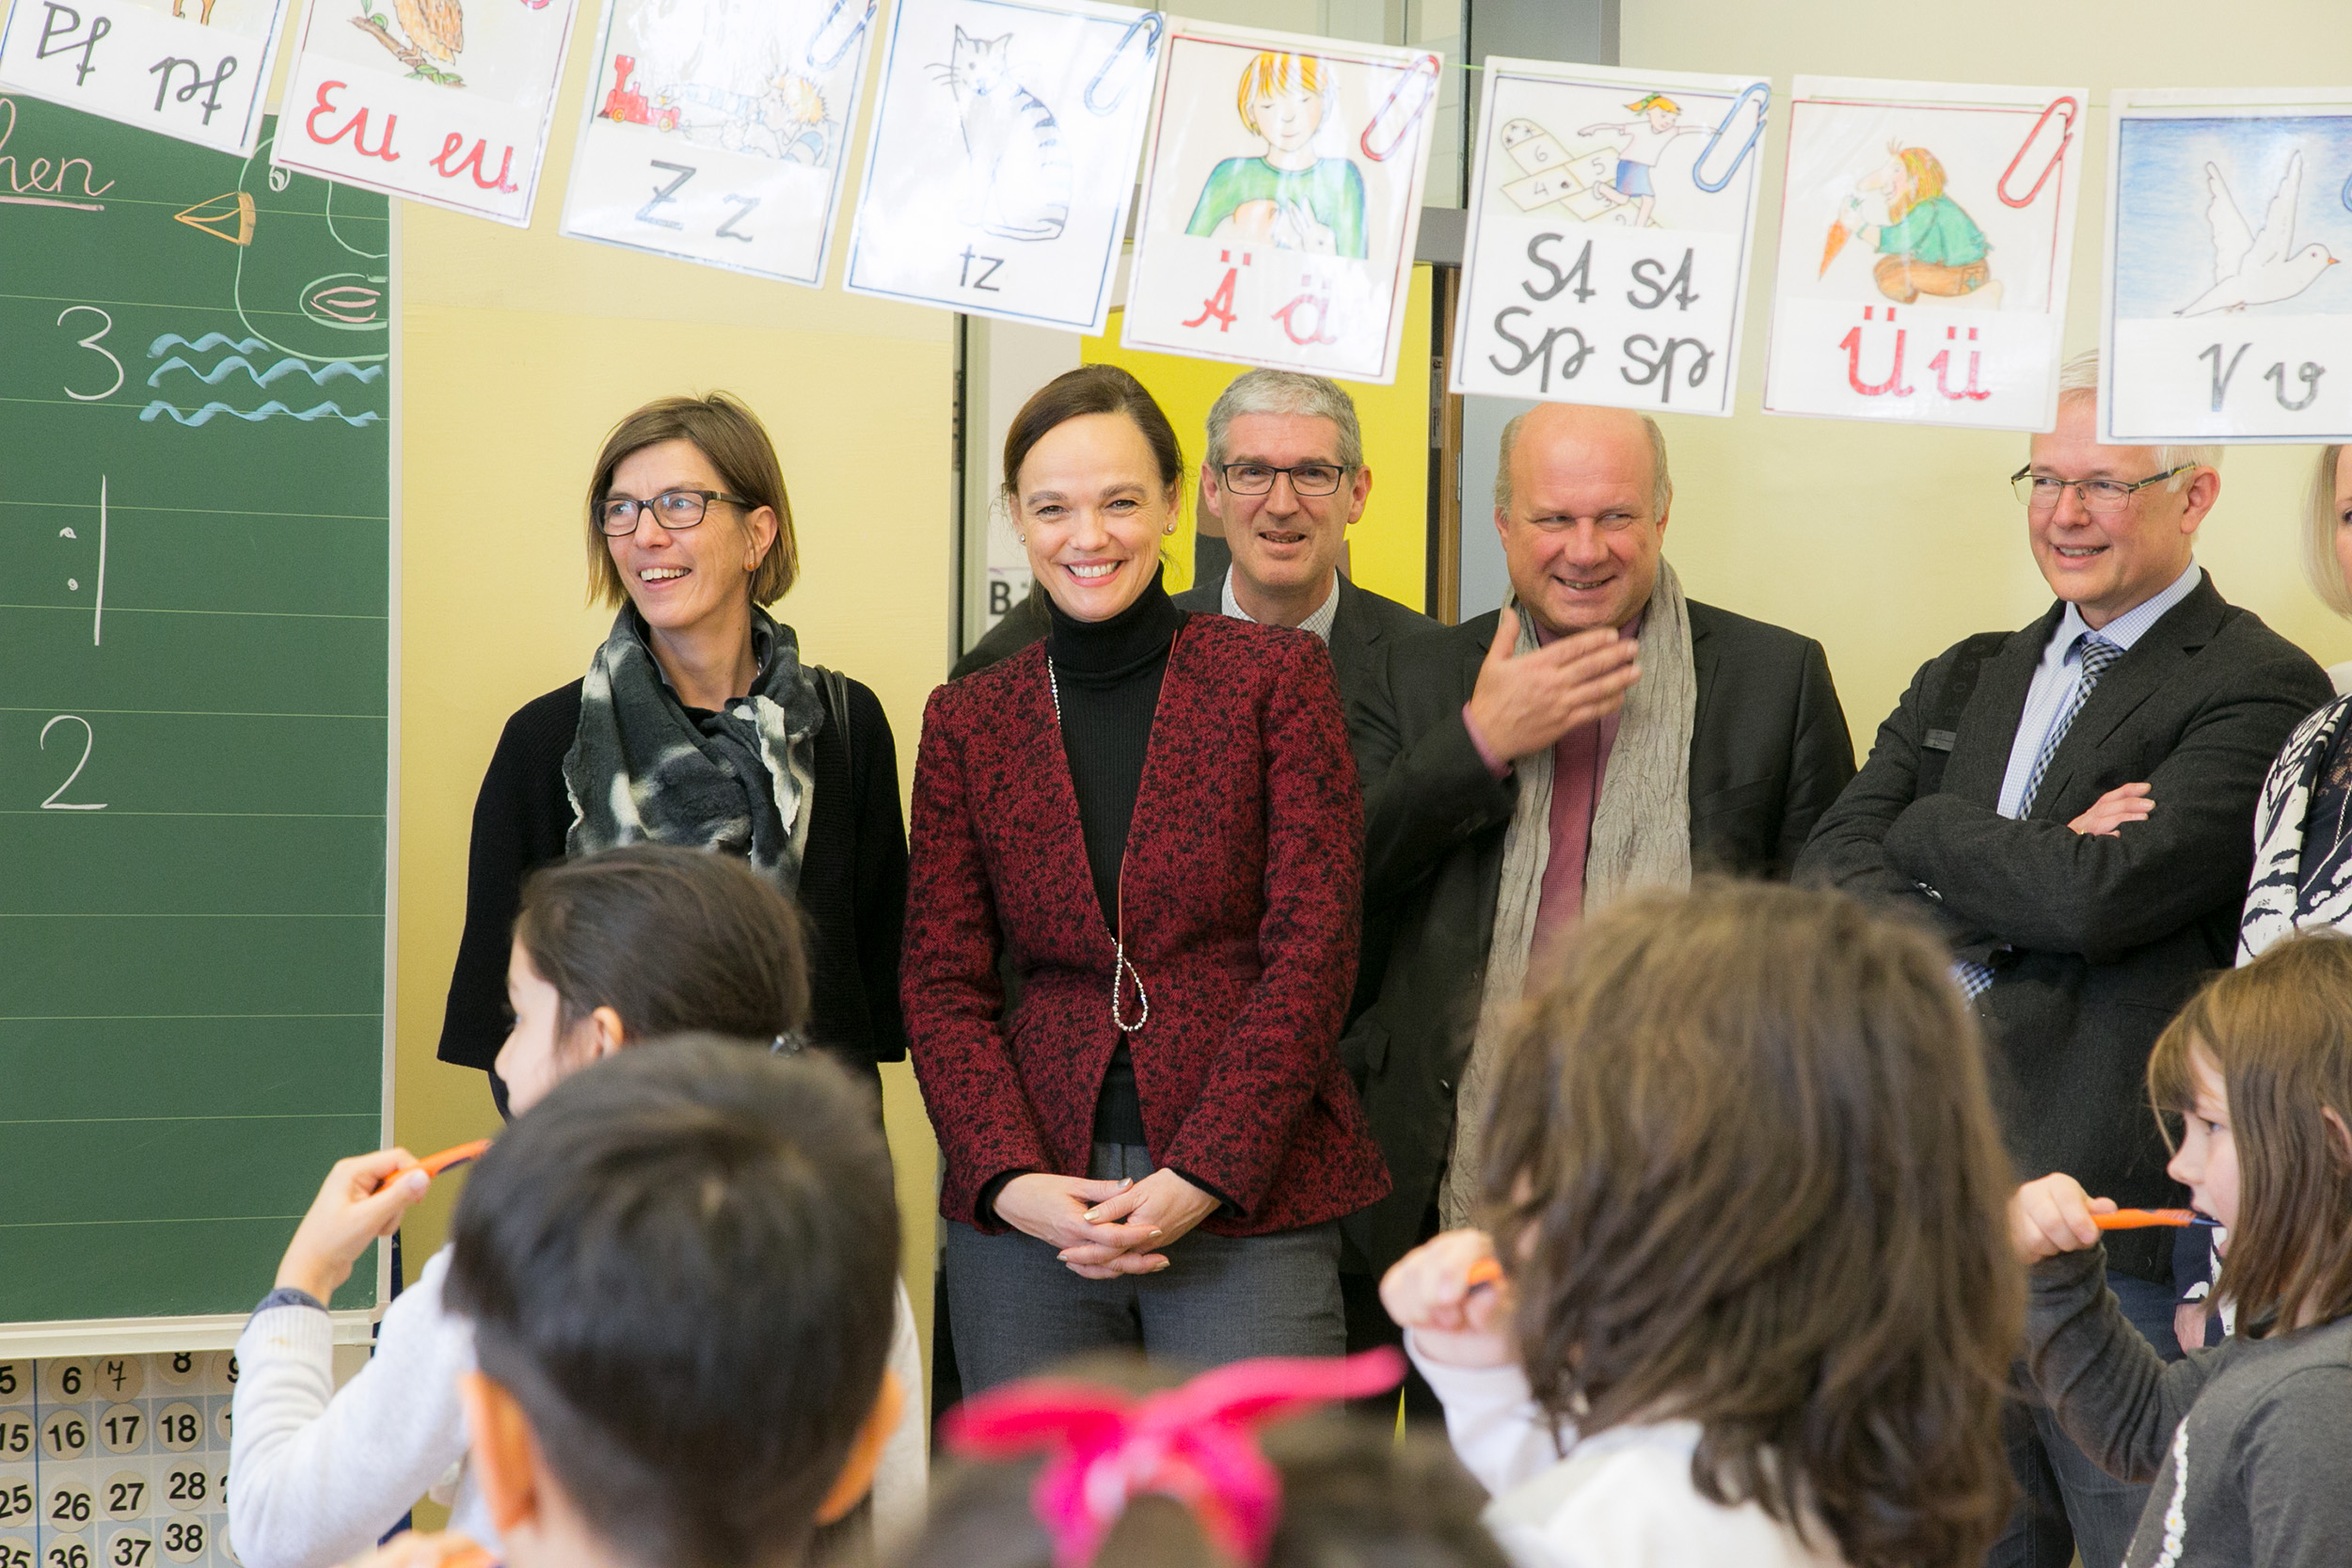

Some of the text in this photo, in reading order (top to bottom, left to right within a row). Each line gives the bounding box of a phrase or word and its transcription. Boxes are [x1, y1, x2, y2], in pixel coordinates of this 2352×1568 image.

[307, 81, 518, 194] Eu eu
[1534, 145, 1549, 162] 6
[1591, 157, 1606, 175] 5
[635, 159, 760, 242] Z z
[960, 244, 1004, 292] tz
[1182, 250, 1337, 346] Ä ä
[1522, 233, 1700, 311] St st
[57, 306, 124, 401] 3
[1489, 307, 1715, 403] Sp sp
[1839, 306, 1992, 401] Ü ü
[2199, 342, 2326, 412] V v
[40, 715, 108, 810] 2
[62, 1367, 82, 1395] 6
[107, 1361, 127, 1391] 7
[49, 1421, 86, 1452] 16
[105, 1416, 140, 1445] 17
[161, 1415, 197, 1443] 18
[52, 1491, 91, 1521] 26
[109, 1483, 145, 1512] 27
[169, 1472, 206, 1500] 28
[115, 1538, 151, 1567] 37
[166, 1524, 203, 1552] 38
